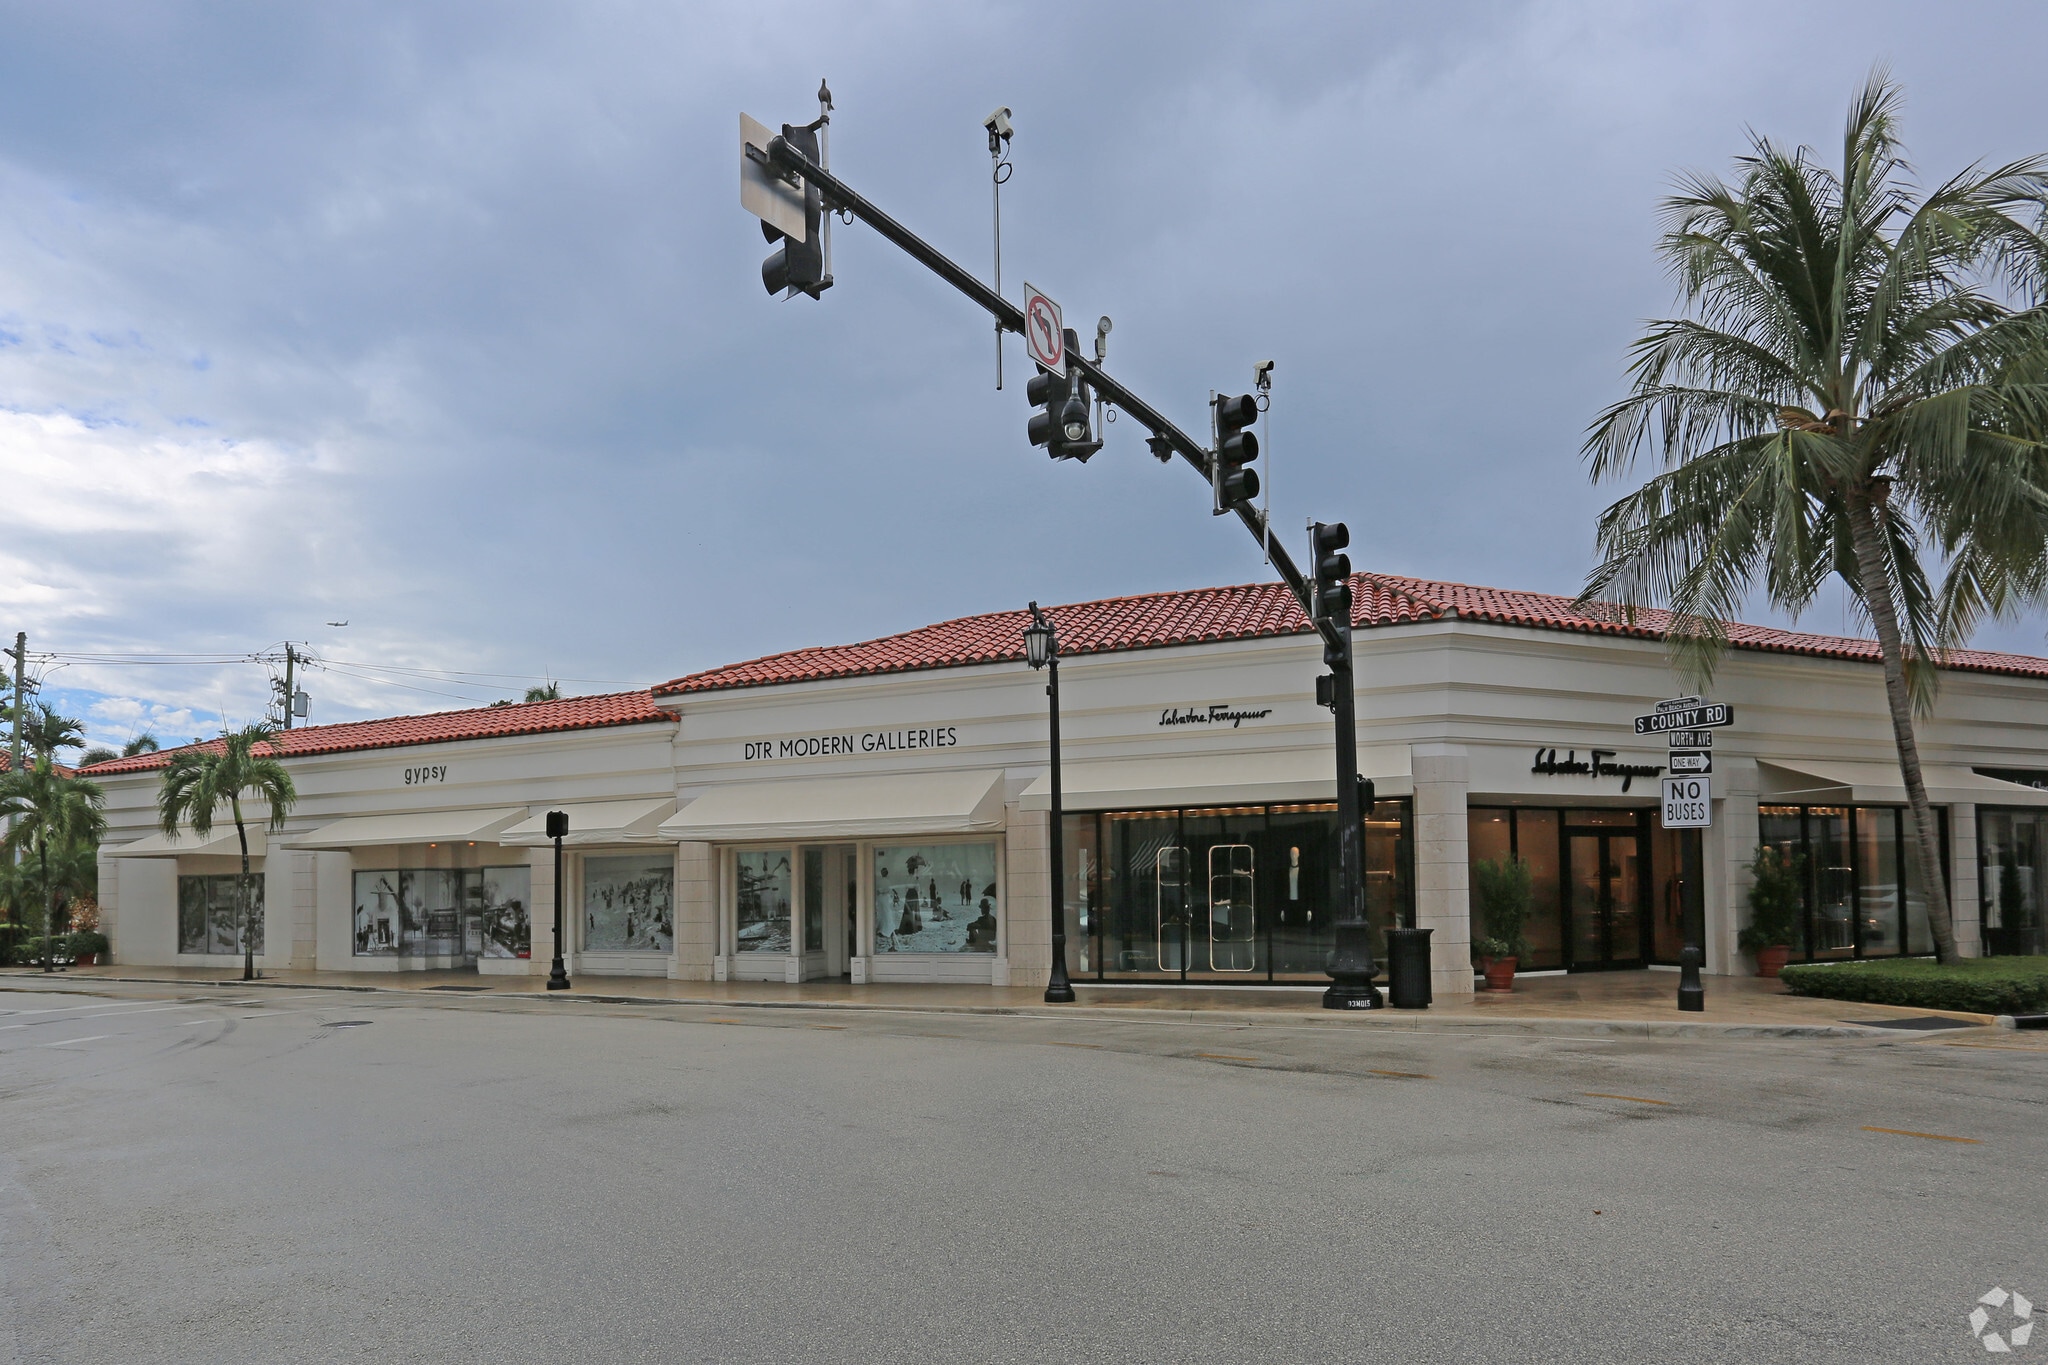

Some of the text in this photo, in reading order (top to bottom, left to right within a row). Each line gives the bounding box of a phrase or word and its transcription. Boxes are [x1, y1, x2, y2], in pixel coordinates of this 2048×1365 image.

[1159, 705, 1272, 728] Salvatore Ferragamo
[1637, 706, 1723, 732] S COUNTY RD
[745, 727, 957, 760] DTR MODERN GALLERIES
[1670, 731, 1711, 746] WORTH AVE
[1673, 757, 1700, 768] ONE WAY
[404, 765, 447, 785] gypsy
[1671, 781, 1701, 800] NO
[1667, 802, 1705, 821] BUSES
